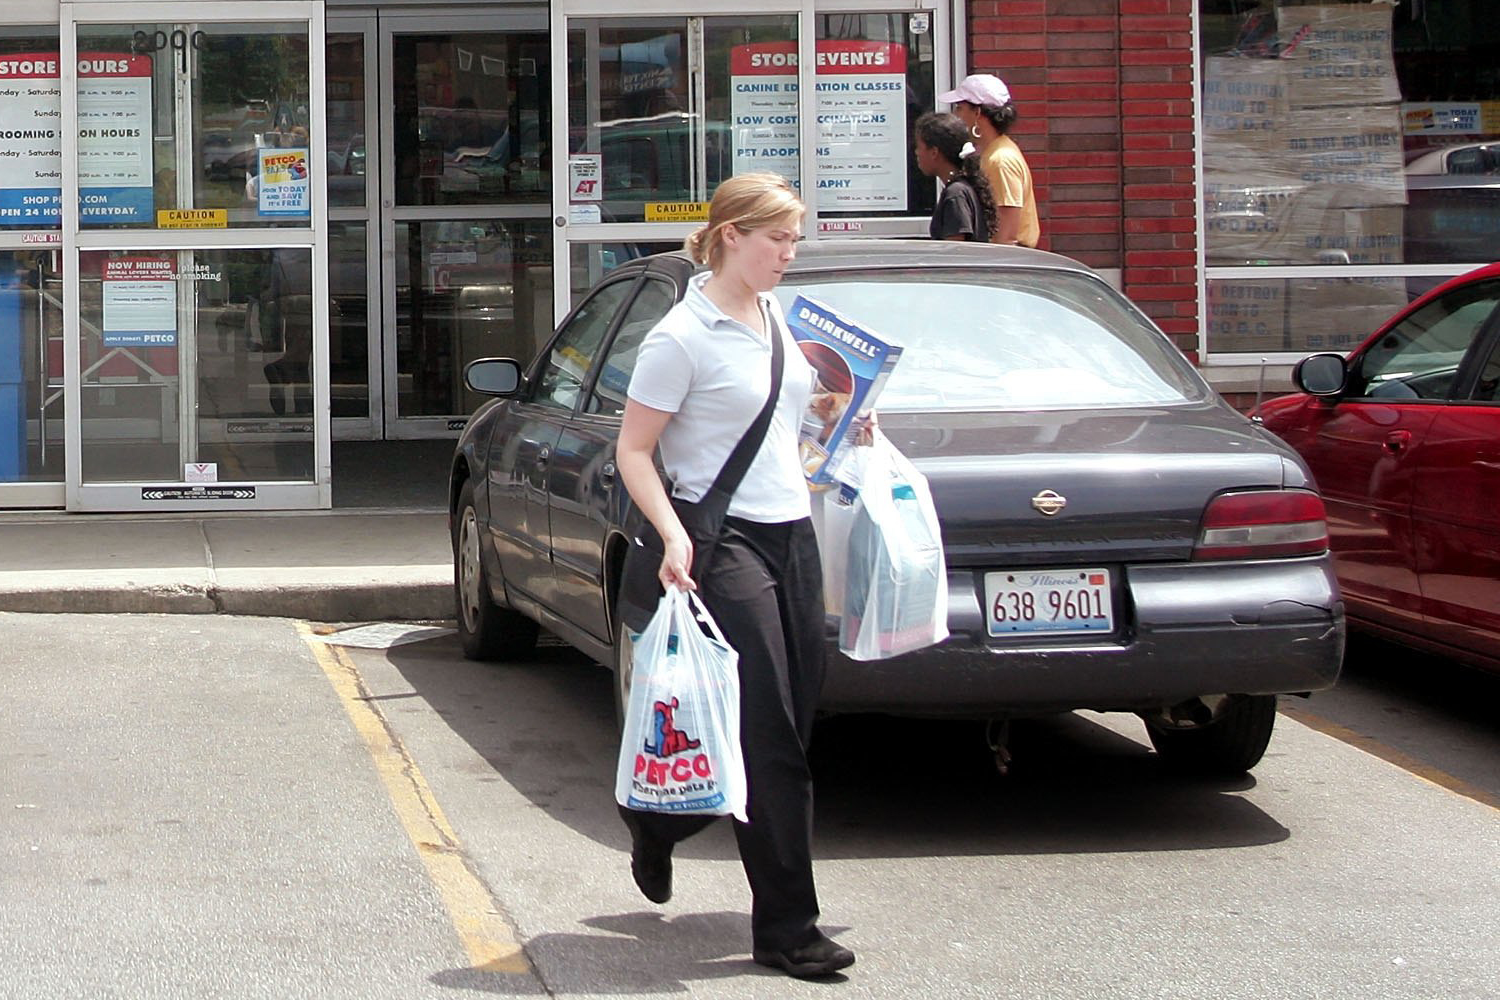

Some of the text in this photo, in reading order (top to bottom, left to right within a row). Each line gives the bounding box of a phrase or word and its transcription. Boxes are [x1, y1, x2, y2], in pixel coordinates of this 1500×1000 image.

[751, 52, 885, 67] STOR EVENTS
[78, 60, 129, 73] OURS
[736, 82, 901, 93] CANINE CLASSES
[736, 115, 797, 125] LOW COST
[101, 129, 141, 138] HOURS
[737, 149, 757, 157] PET
[264, 155, 296, 166] PETCO
[23, 196, 49, 205] SHOP
[25, 208, 39, 217] 24
[83, 207, 137, 215] EVERYDAY.
[656, 204, 702, 213] CAUTION
[169, 211, 215, 219] CAUTION
[847, 222, 862, 230] BACK
[108, 261, 171, 270] NOW HIRING
[181, 264, 210, 274] please
[183, 272, 222, 282] smoking
[799, 307, 876, 358] DRINKWELL
[1029, 574, 1080, 586] Illinois
[993, 589, 1106, 622] 638 9601
[634, 753, 712, 787] PETCO
[678, 782, 704, 795] pets
